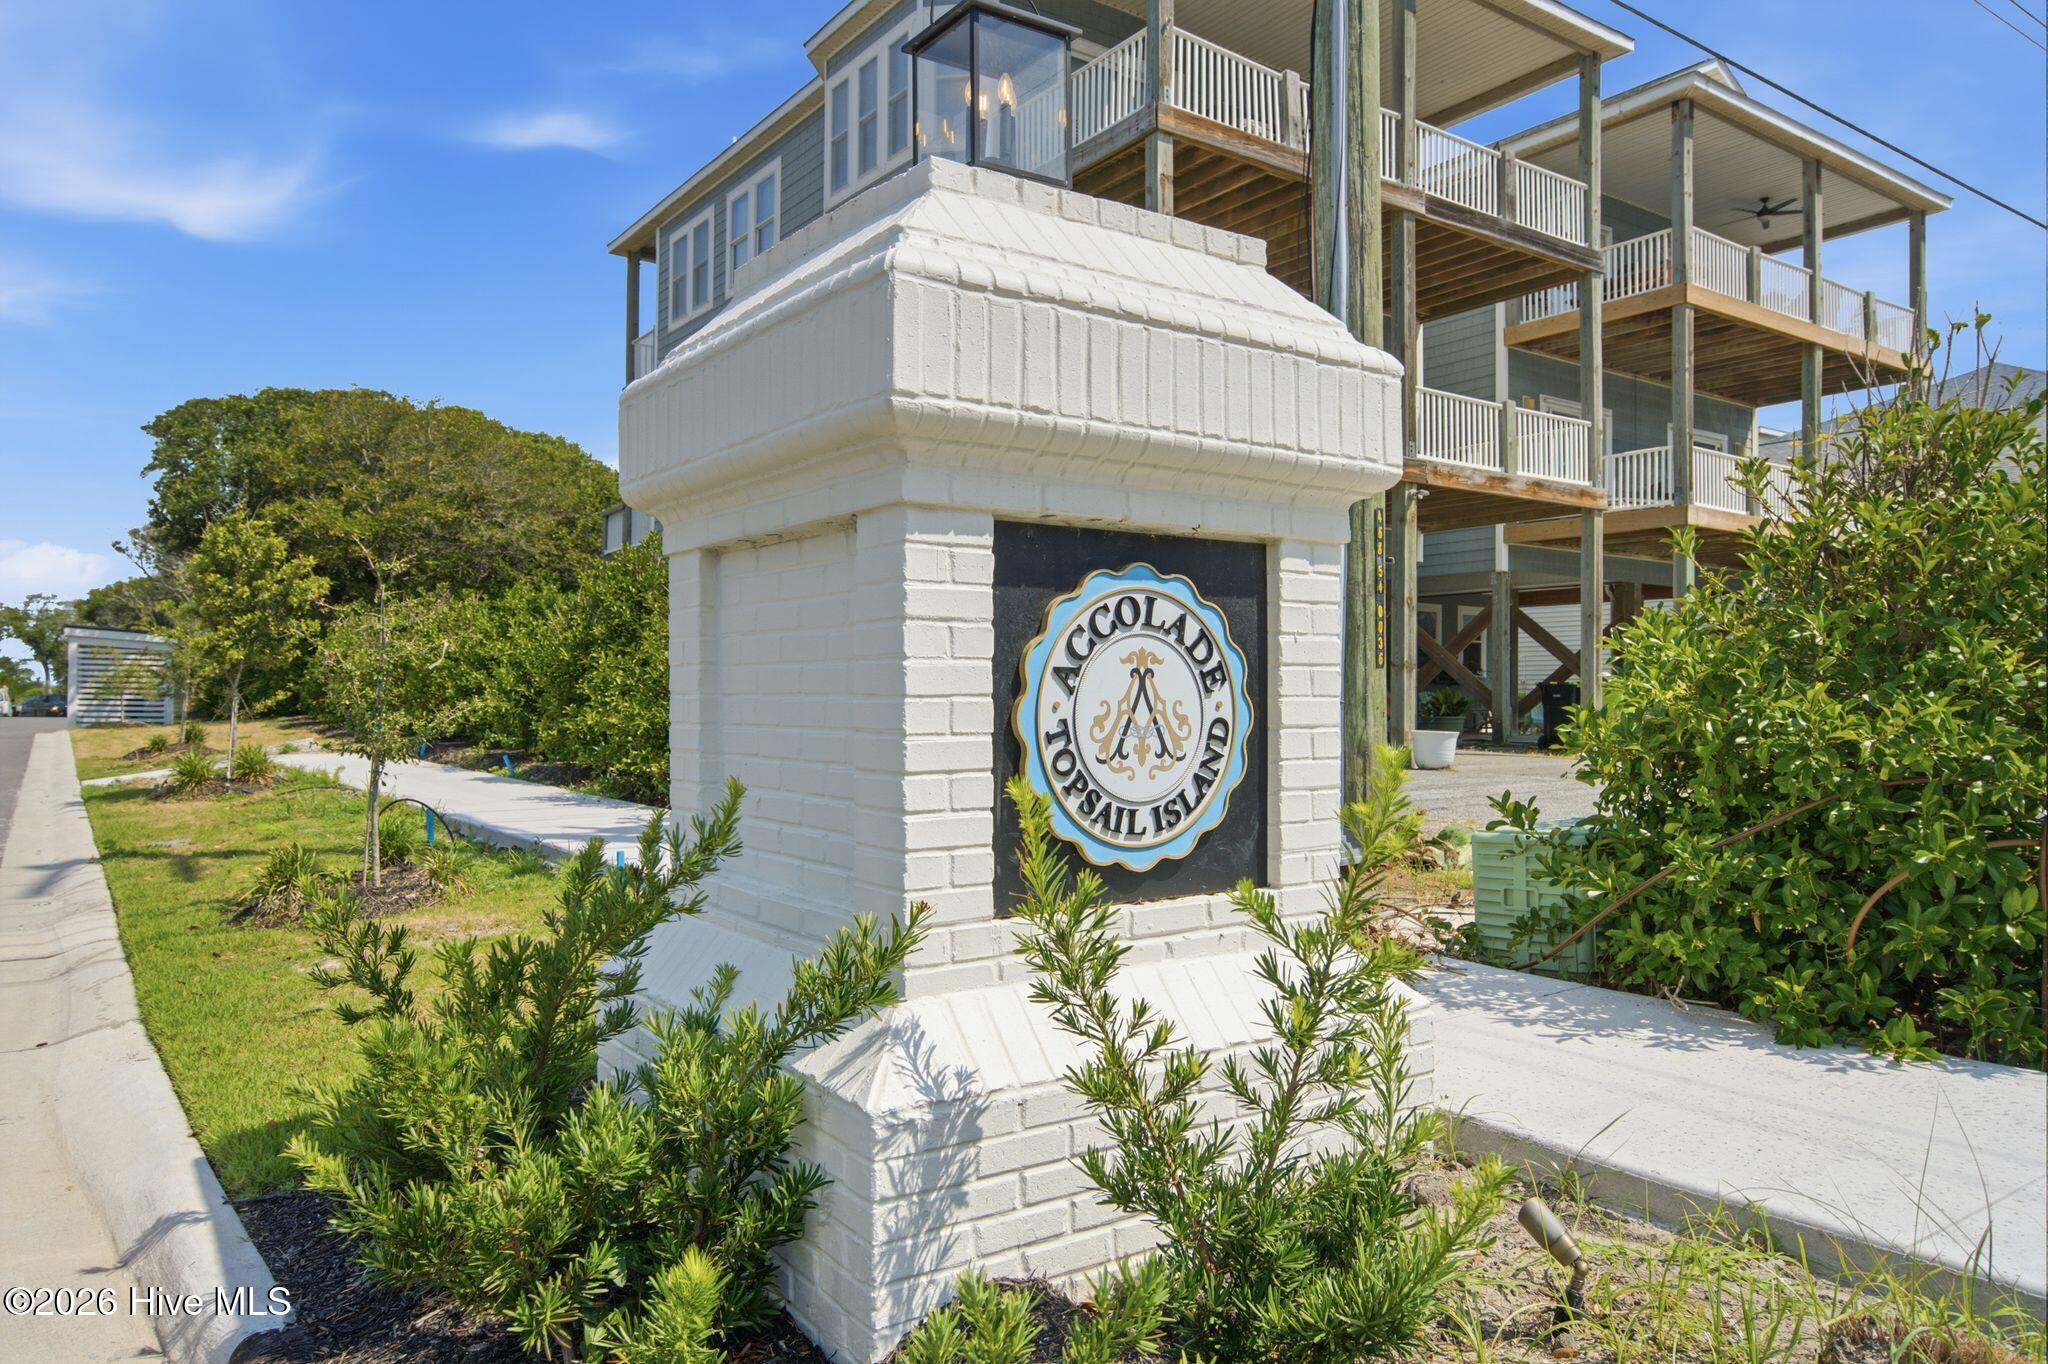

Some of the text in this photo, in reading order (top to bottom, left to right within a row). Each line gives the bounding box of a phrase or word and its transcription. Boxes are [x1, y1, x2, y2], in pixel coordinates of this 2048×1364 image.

[1053, 595, 1228, 695] ACCOLADE
[1046, 717, 1230, 835] TOPSAIL ISLAND
